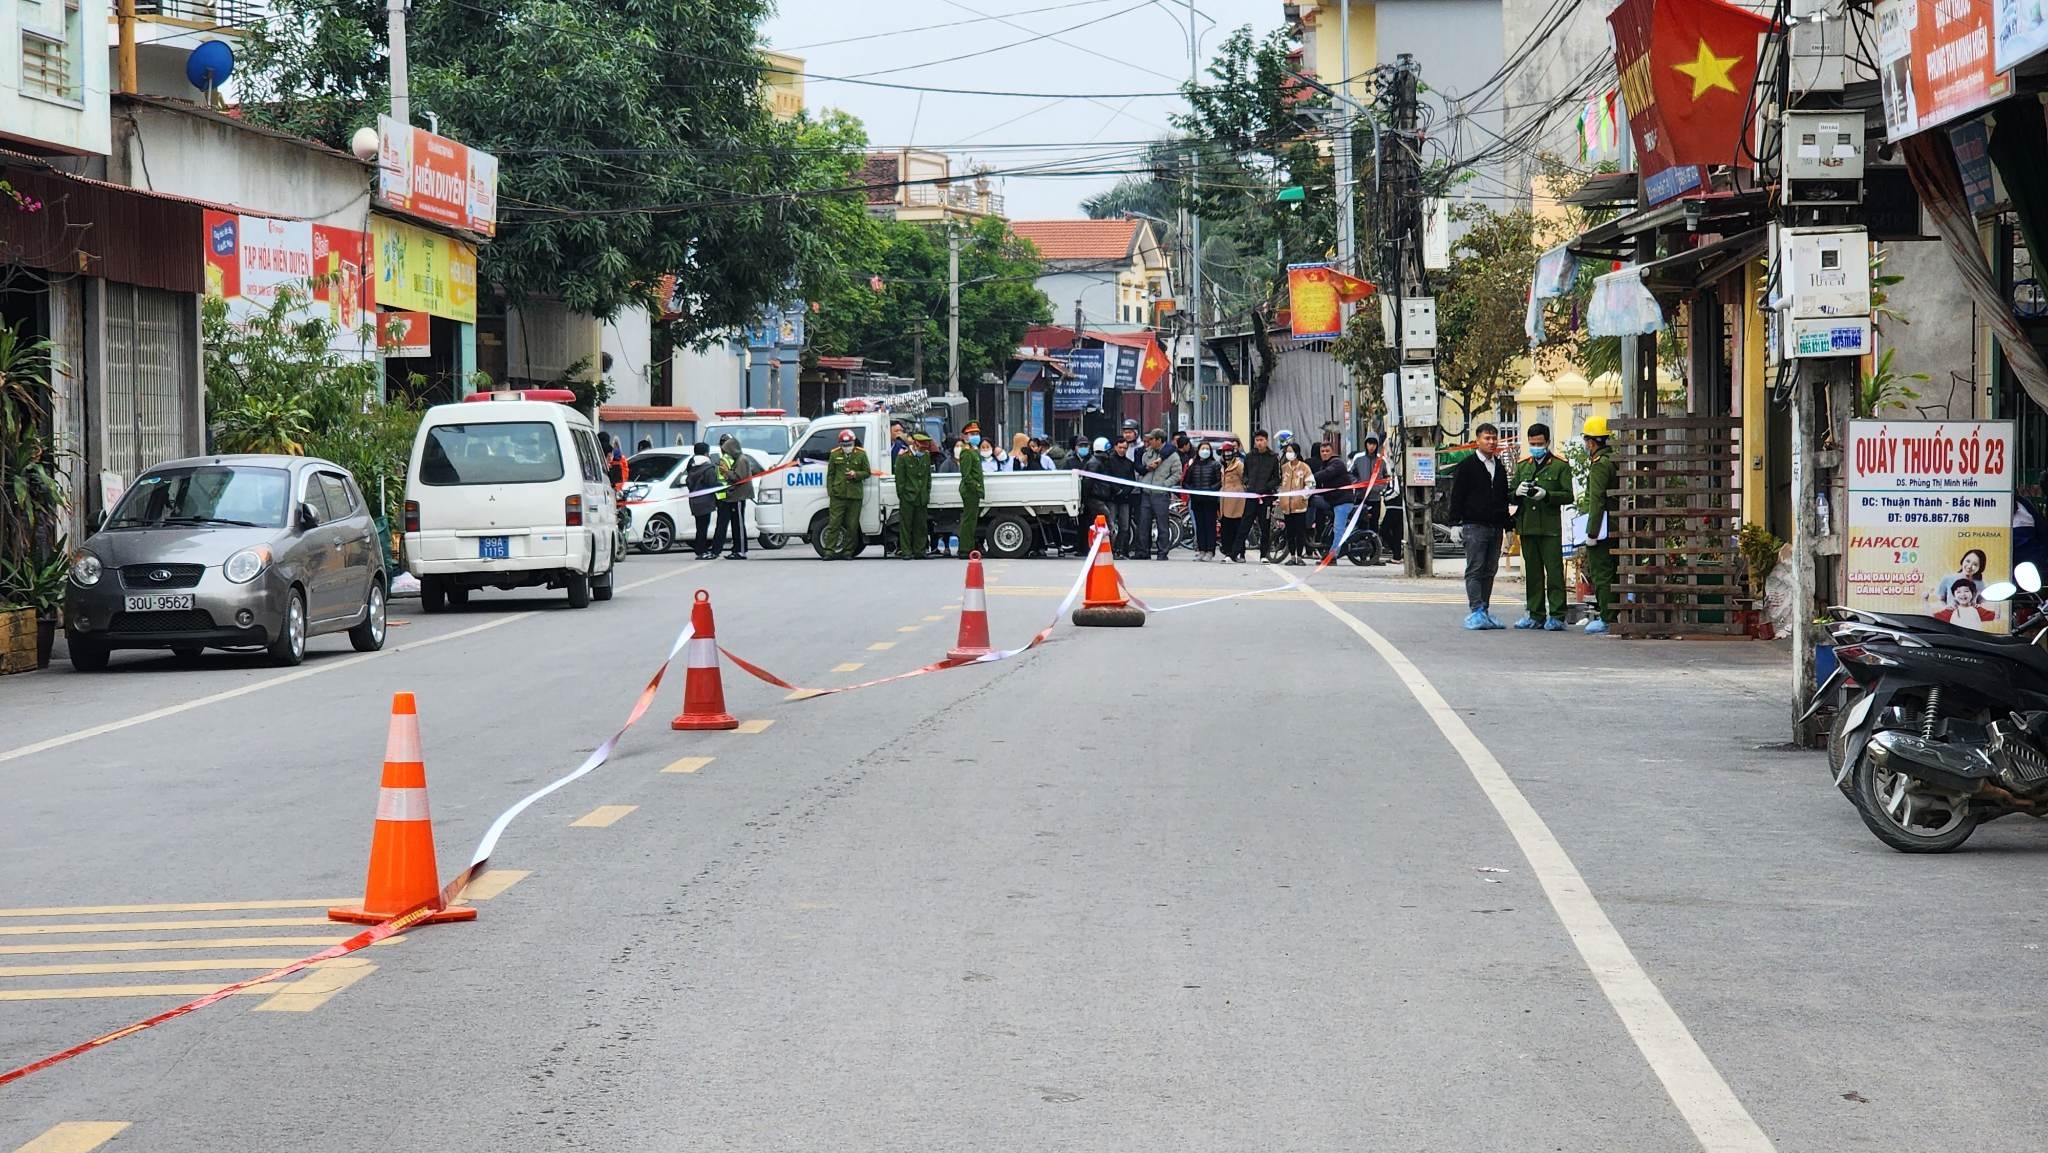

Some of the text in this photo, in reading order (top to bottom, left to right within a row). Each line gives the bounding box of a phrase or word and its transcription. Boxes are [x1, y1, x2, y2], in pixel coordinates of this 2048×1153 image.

[435, 171, 465, 207] DUYÊN
[1856, 425, 2004, 477] QUẦY THUỐC SỐ 23
[1896, 479, 1907, 487] DS.
[1909, 479, 1931, 488] Phùng
[1944, 479, 1961, 487] Minh
[1862, 497, 1878, 507] ĐC:
[1882, 497, 1910, 509] Thuận
[1913, 497, 1942, 507] Thành
[1952, 495, 1971, 507] Bắc
[1973, 498, 1997, 508] Ninh
[1888, 513, 1970, 523] ĐT: 0976.867.768
[485, 537, 503, 547] 99A
[1850, 536, 1920, 548] HAPACOL
[484, 547, 504, 557] 1115
[1894, 551, 1918, 564] 250
[1882, 585, 1901, 595] CHO
[128, 596, 189, 610] 30U-9562
